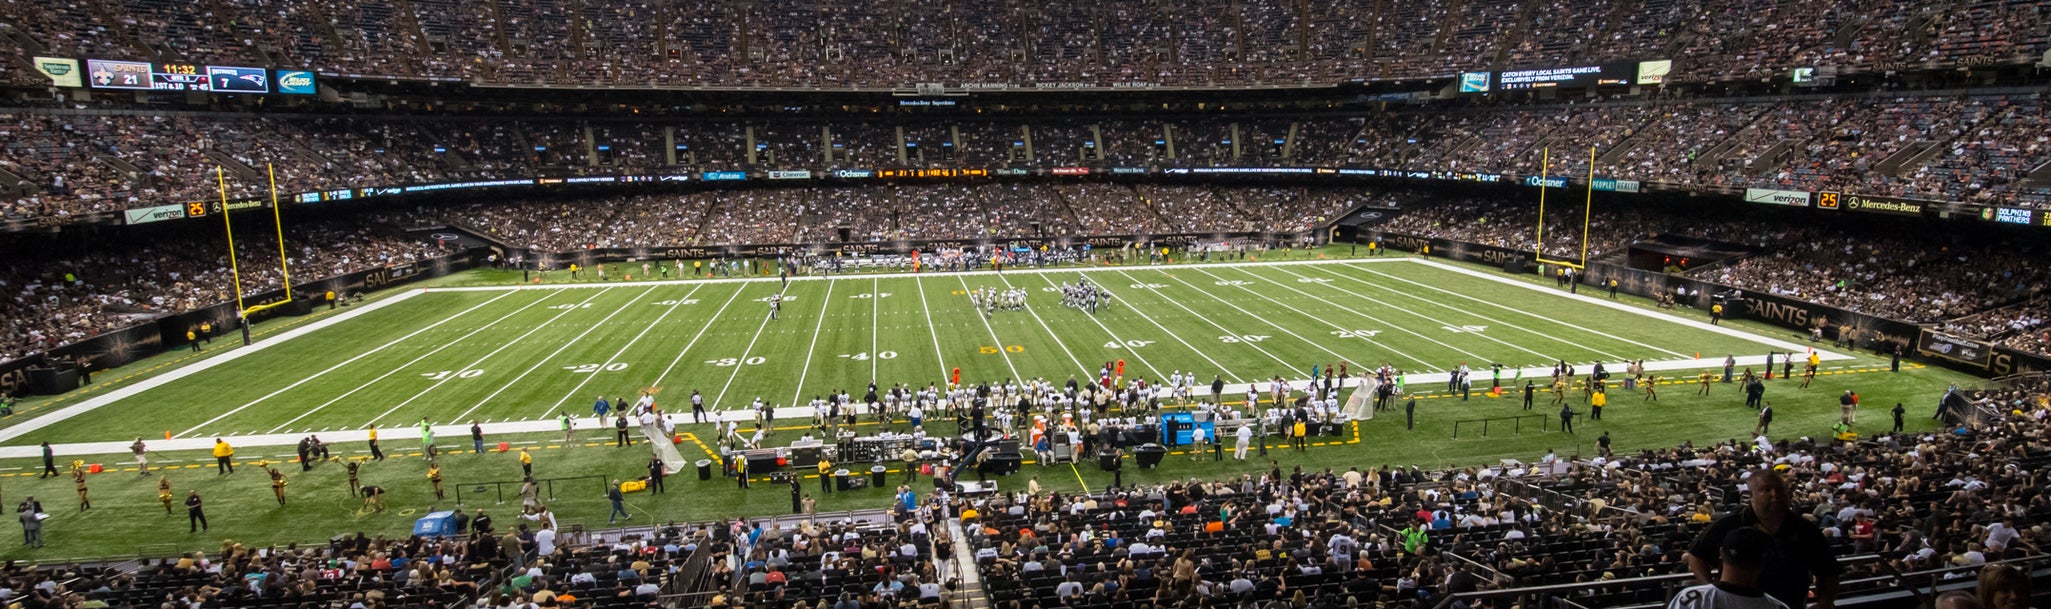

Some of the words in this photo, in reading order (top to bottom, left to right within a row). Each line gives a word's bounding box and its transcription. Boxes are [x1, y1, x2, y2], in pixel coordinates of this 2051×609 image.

[1957, 56, 1994, 67] SAINTS
[114, 64, 147, 72] SAINTS
[164, 64, 196, 74] 11:32
[1873, 62, 1906, 72] SAINTS
[124, 74, 138, 84] 21
[221, 78, 229, 88] 7
[840, 170, 869, 178] Ochsner
[1592, 180, 1615, 189] PEOPLES
[1616, 181, 1639, 190] HEALTH
[1774, 194, 1806, 204] verizon
[1820, 193, 1837, 206] 25
[189, 202, 204, 216] 25
[1861, 200, 1921, 213] Mercedes-Benz
[152, 209, 182, 220] verizon
[1999, 208, 2032, 217] DOLPHINS
[1998, 215, 2030, 224] PANTHERS
[1089, 238, 1120, 247] SAINTS
[1396, 237, 1429, 250] SAINTS
[667, 249, 704, 258] SAINTS
[757, 247, 793, 256] SAINTS
[843, 244, 878, 253] SAINTS
[1745, 298, 1808, 326] SAINTS
[1932, 333, 1980, 349] PlayFootball.com
[1340, 545, 1347, 554] 9
[1679, 590, 1699, 606] 9
